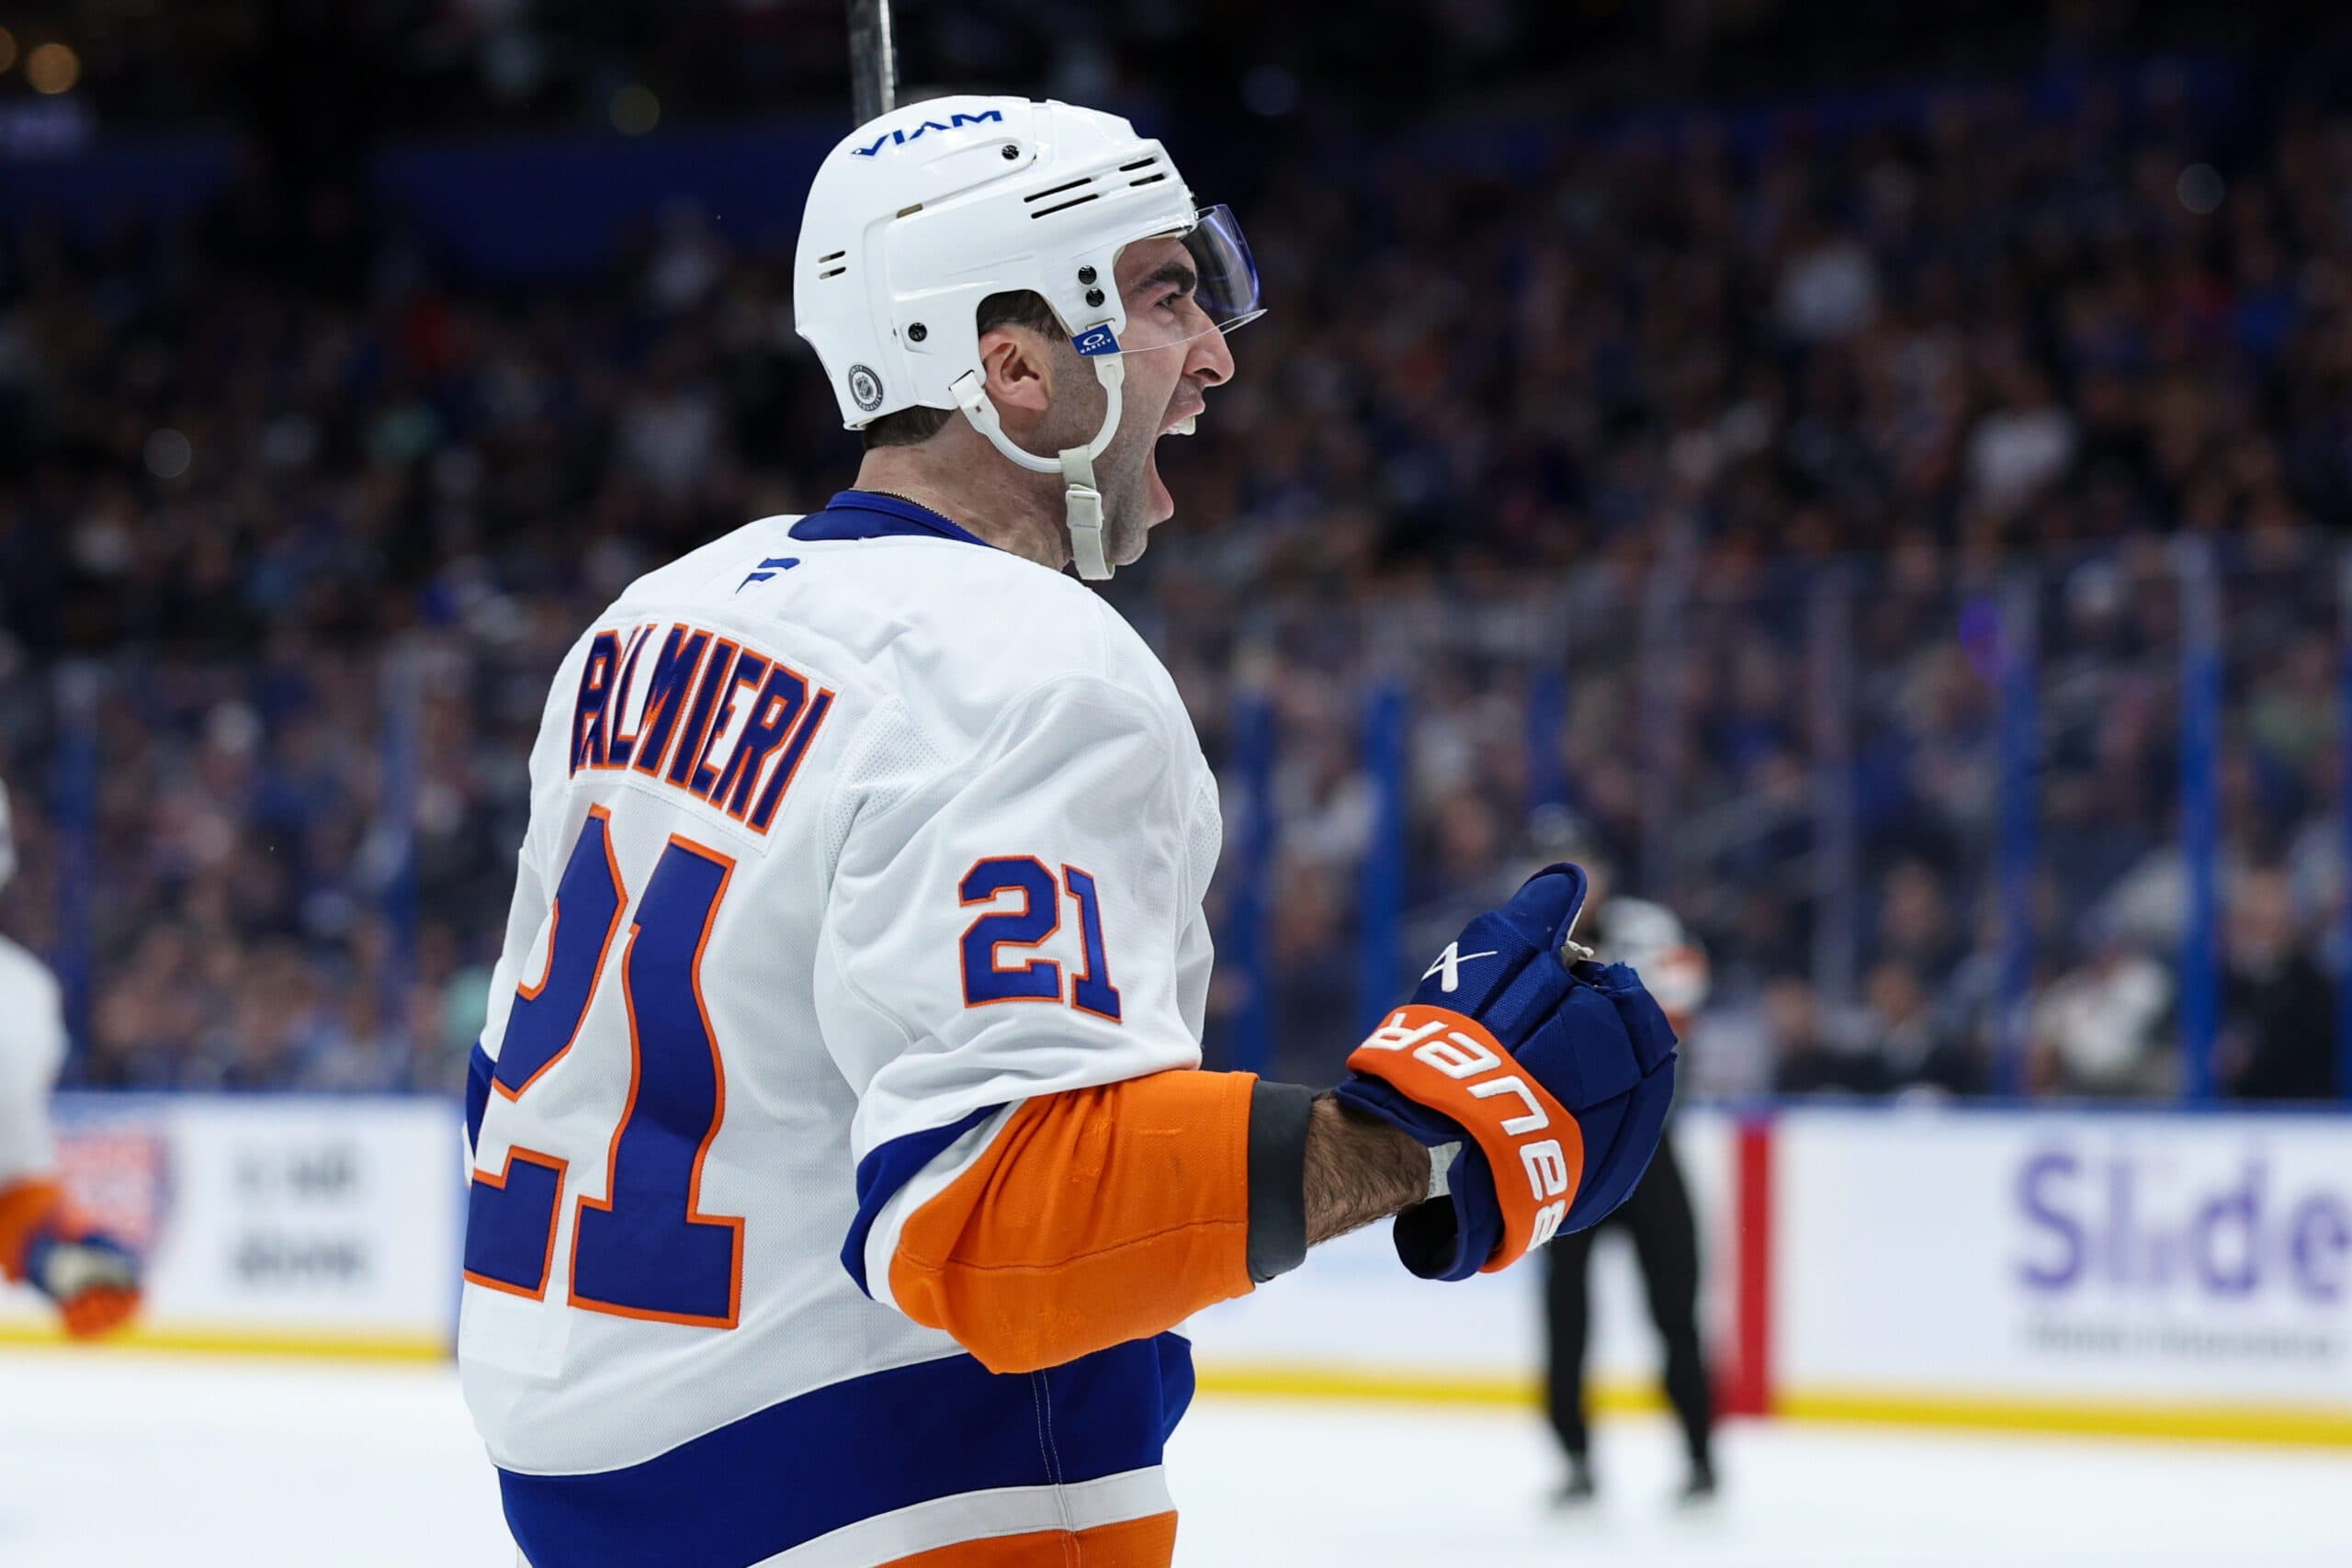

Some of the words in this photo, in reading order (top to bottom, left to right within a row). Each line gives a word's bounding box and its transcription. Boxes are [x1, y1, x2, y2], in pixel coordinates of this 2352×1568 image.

[850, 110, 1002, 156] VIAM
[1080, 337, 1112, 355] OAKLEY
[958, 854, 1123, 1025] 21
[463, 802, 745, 1329] 21
[1360, 1011, 1569, 1252] BAUER
